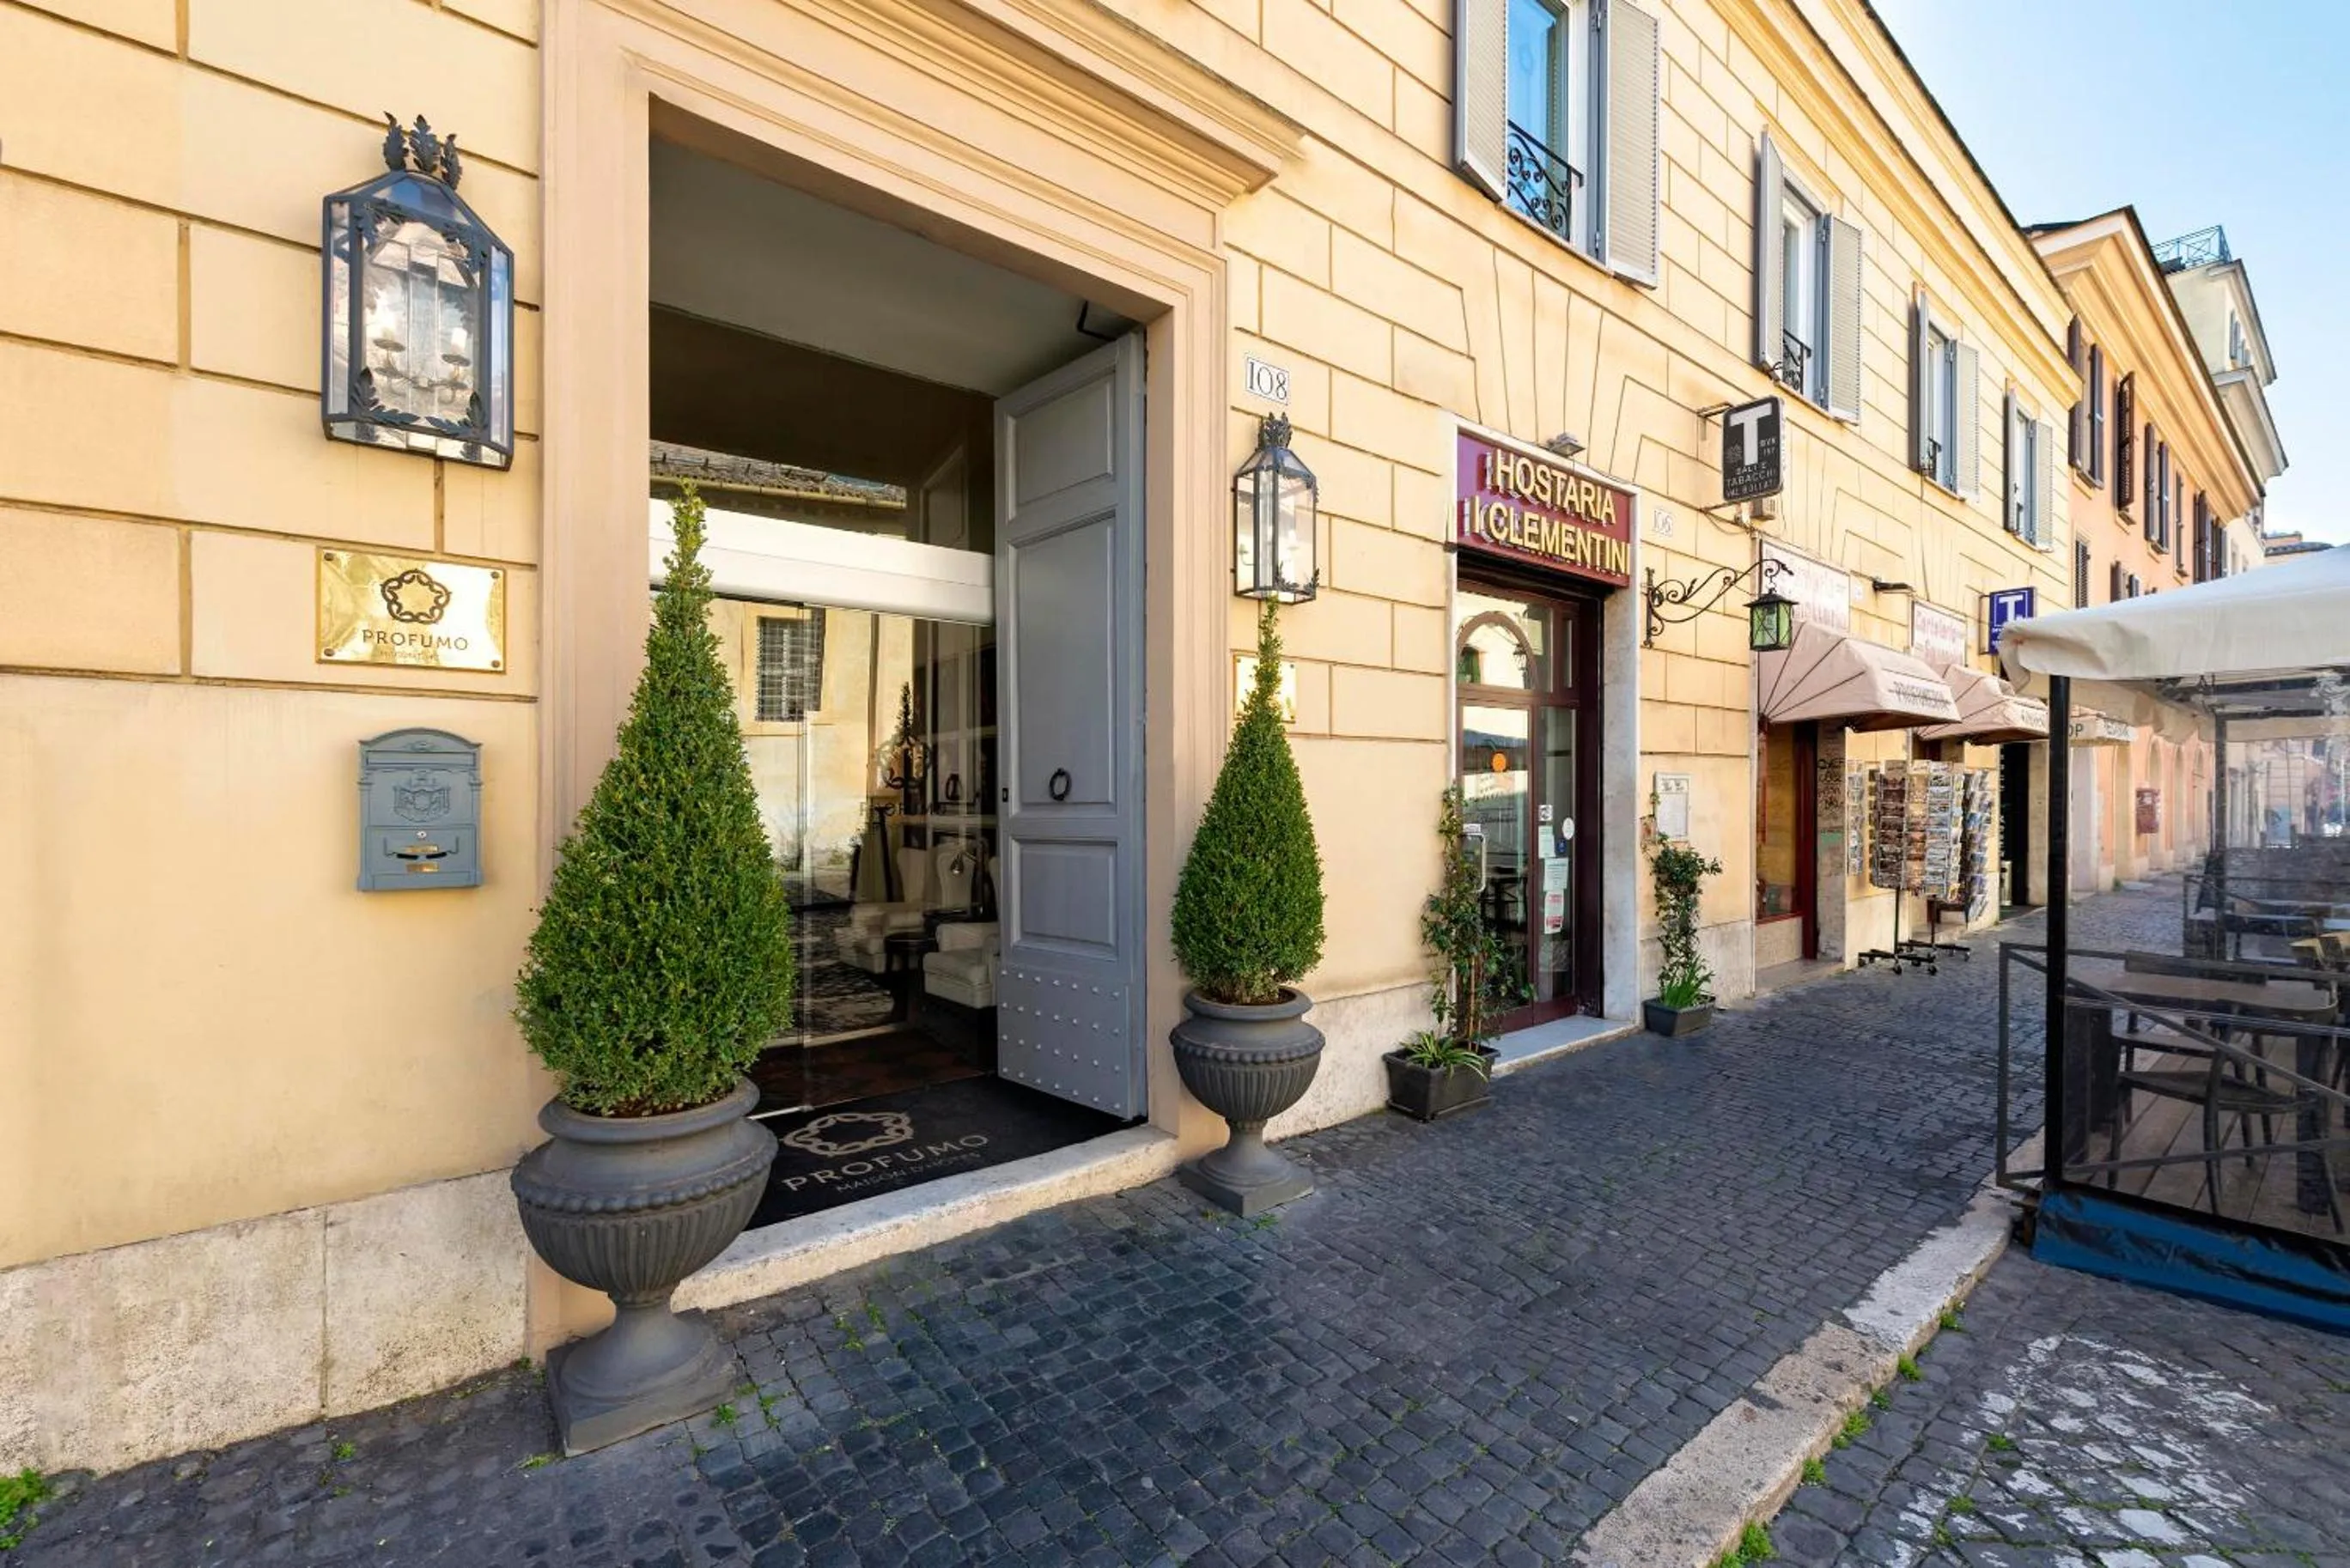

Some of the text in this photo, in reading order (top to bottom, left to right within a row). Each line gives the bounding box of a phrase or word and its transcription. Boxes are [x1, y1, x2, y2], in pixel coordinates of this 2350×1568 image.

[1249, 362, 1288, 400] 108
[1729, 402, 1772, 465] T
[1496, 449, 1616, 525] HOSTARIA
[1489, 501, 1630, 575] CLEMENTINI
[362, 629, 469, 651] PROFUMO
[782, 1134, 989, 1192] PROFUMO
